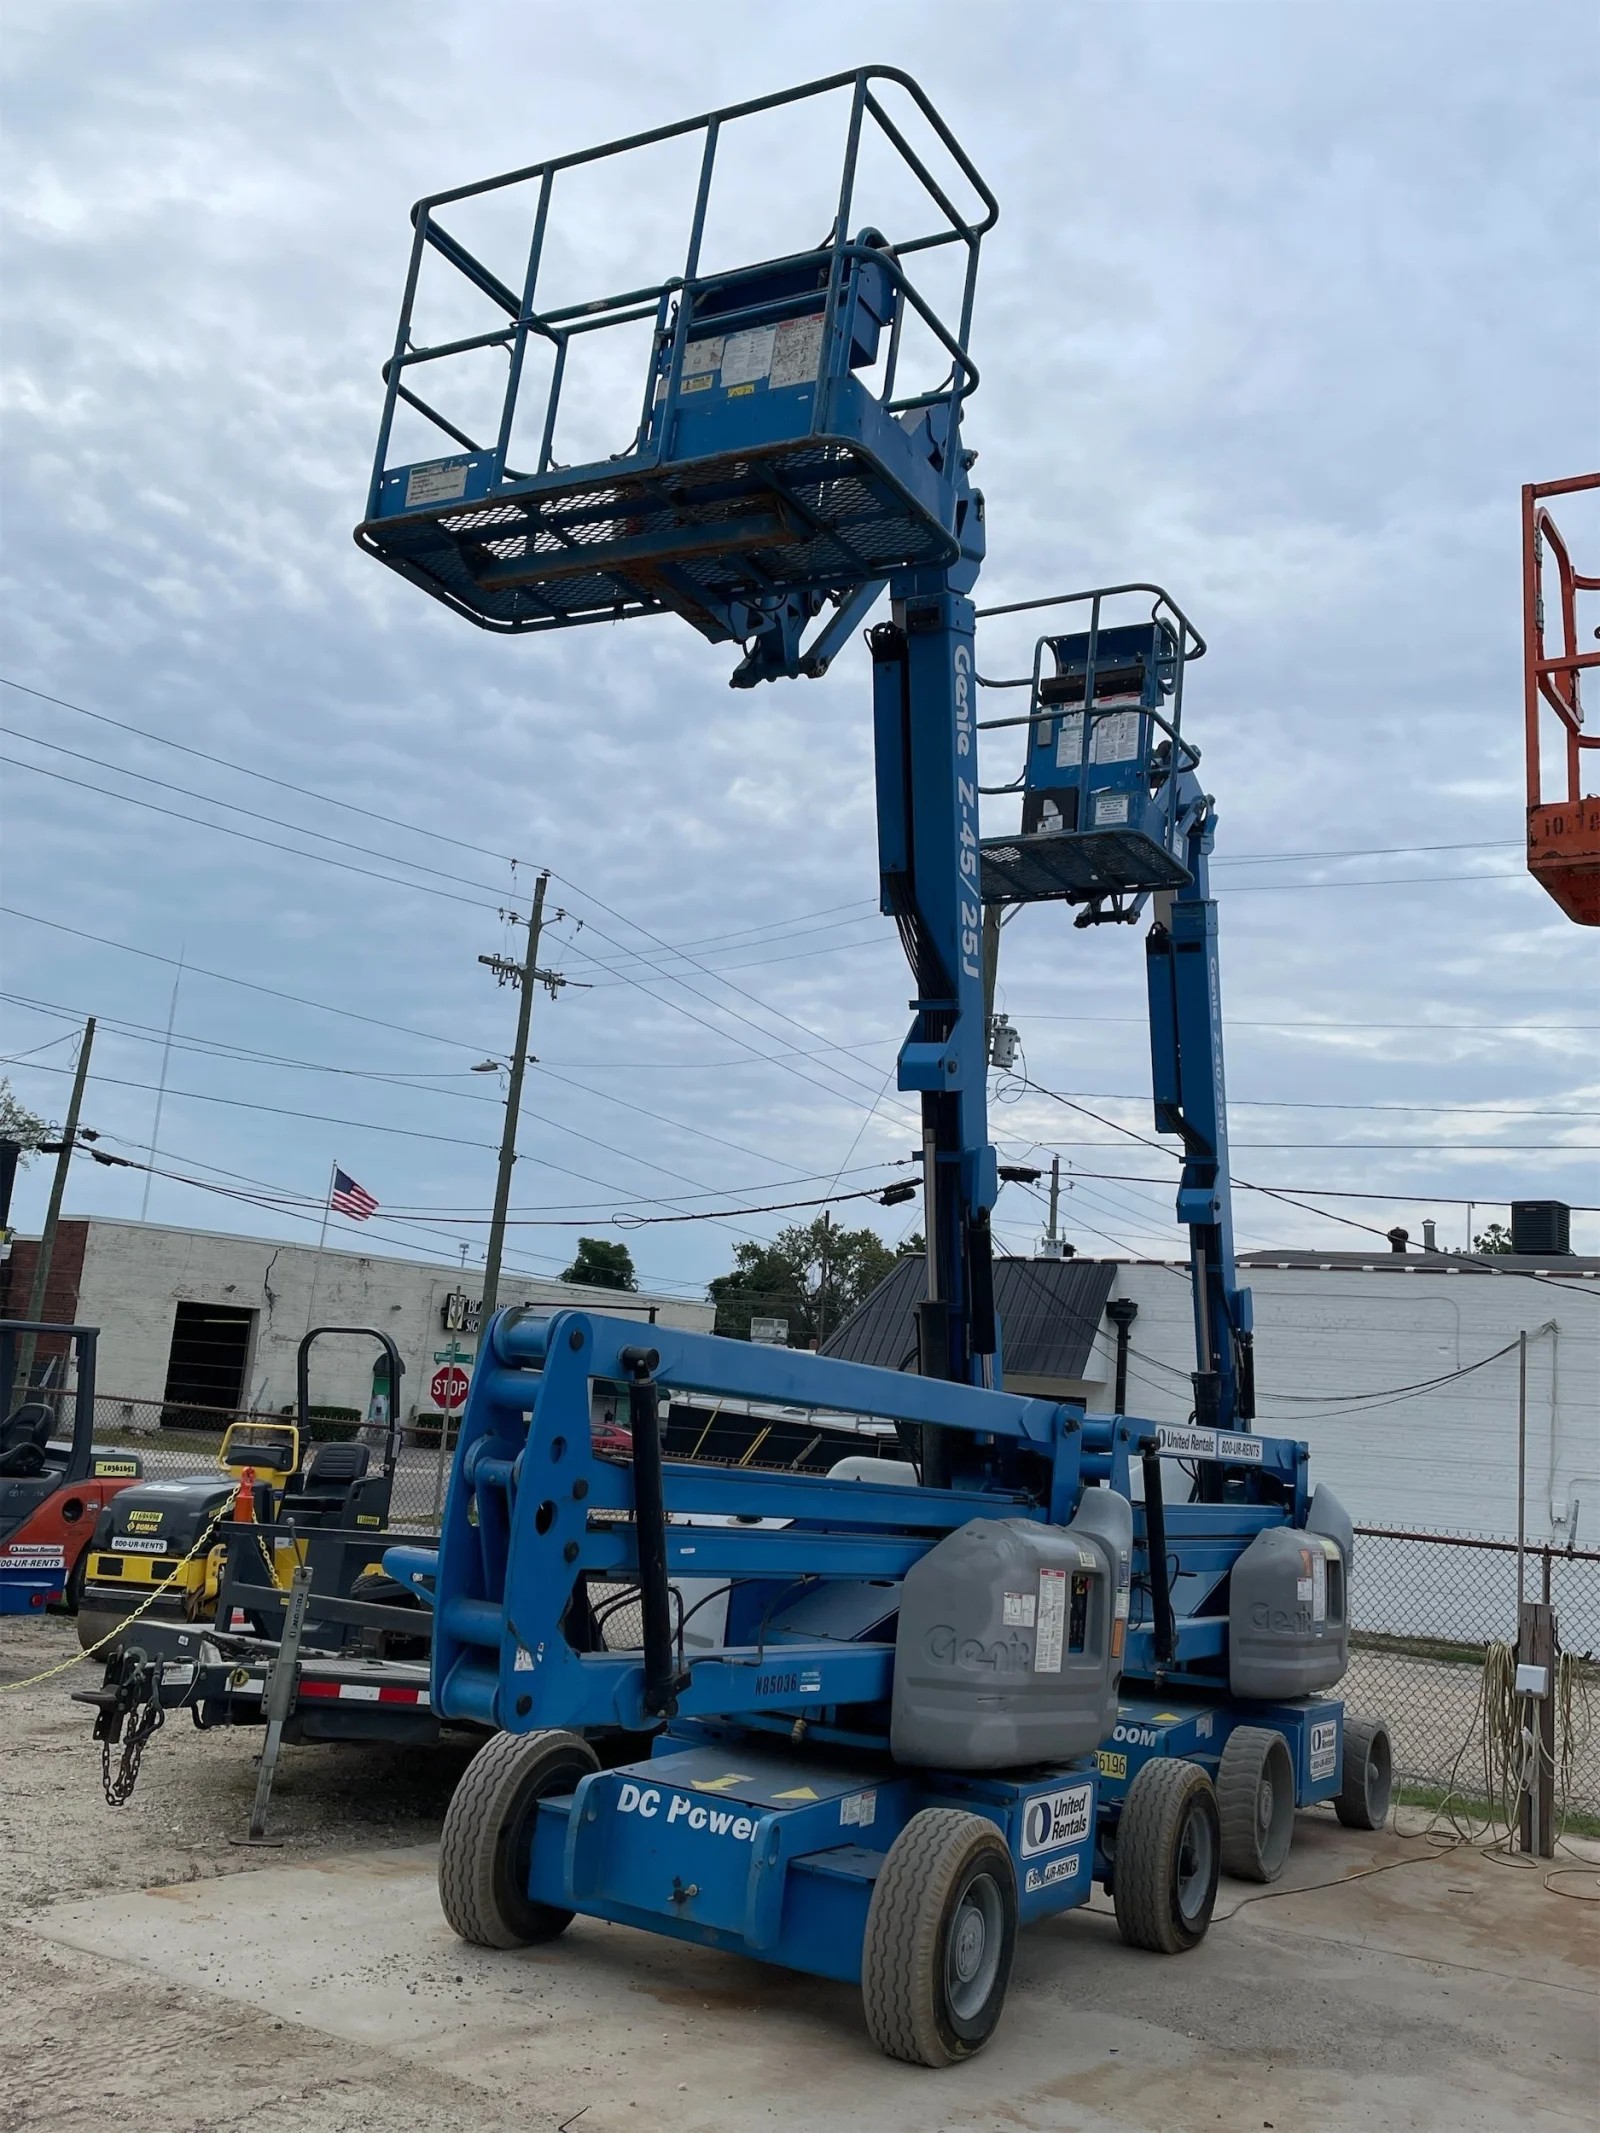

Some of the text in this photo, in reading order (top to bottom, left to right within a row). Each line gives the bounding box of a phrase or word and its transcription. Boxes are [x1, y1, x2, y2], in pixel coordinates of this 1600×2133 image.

[954, 644, 973, 757] Genie
[1209, 956, 1219, 1021] Genie
[432, 1379, 468, 1397] STOP
[1167, 1431, 1214, 1453] United Rentals
[1221, 1440, 1260, 1458] 800-UR-RENTS
[135, 1523, 158, 1532] BOMAG
[114, 1539, 164, 1550] 800-UR-RENTS
[617, 1783, 661, 1818] DC
[1054, 1792, 1087, 1819] United
[1051, 1813, 1087, 1841] Rentals
